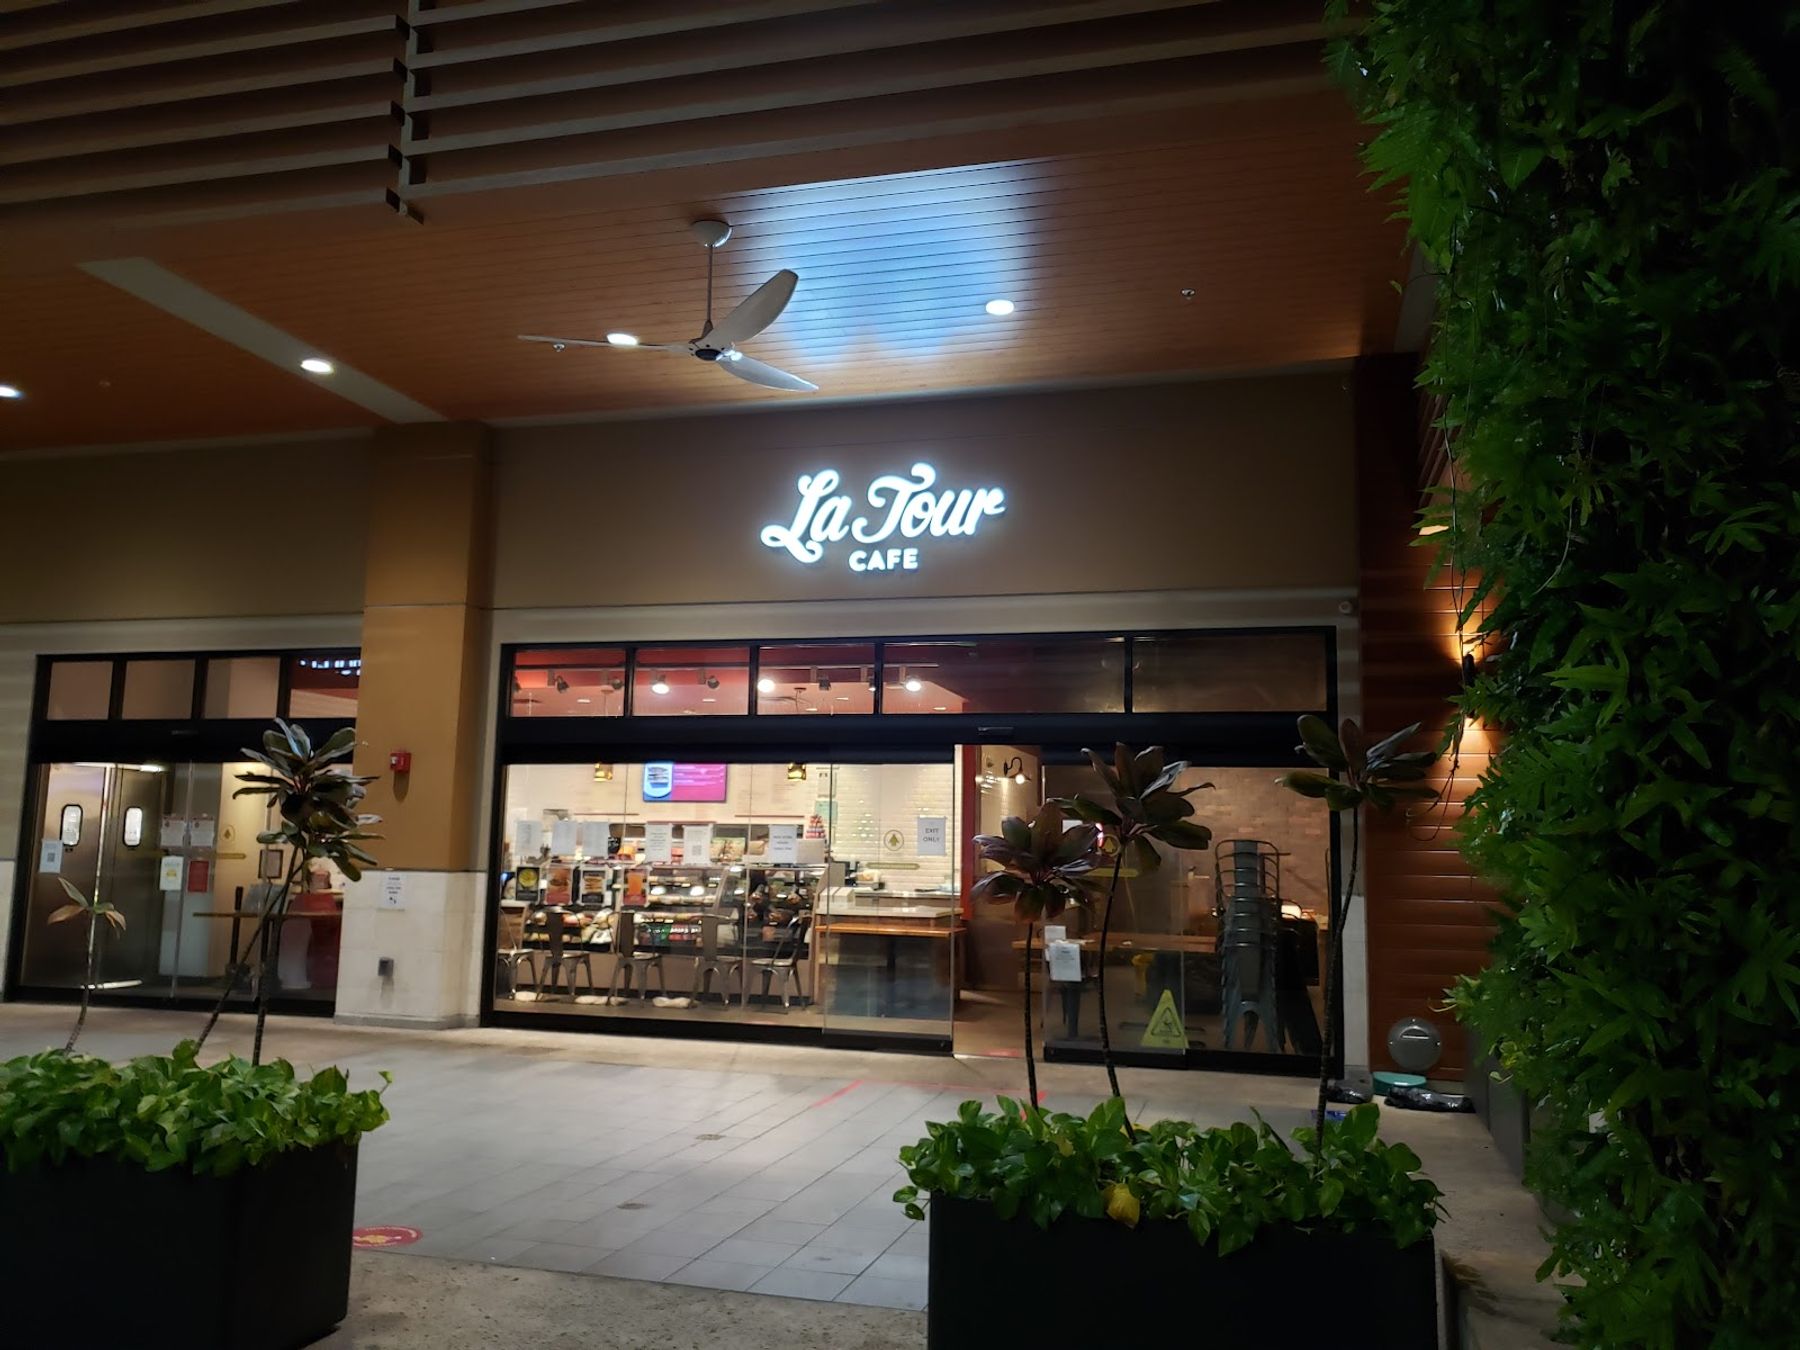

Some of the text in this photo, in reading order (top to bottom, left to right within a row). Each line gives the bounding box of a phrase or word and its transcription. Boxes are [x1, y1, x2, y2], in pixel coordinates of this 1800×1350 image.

[760, 462, 1005, 563] La Tour
[848, 548, 918, 572] CAFE
